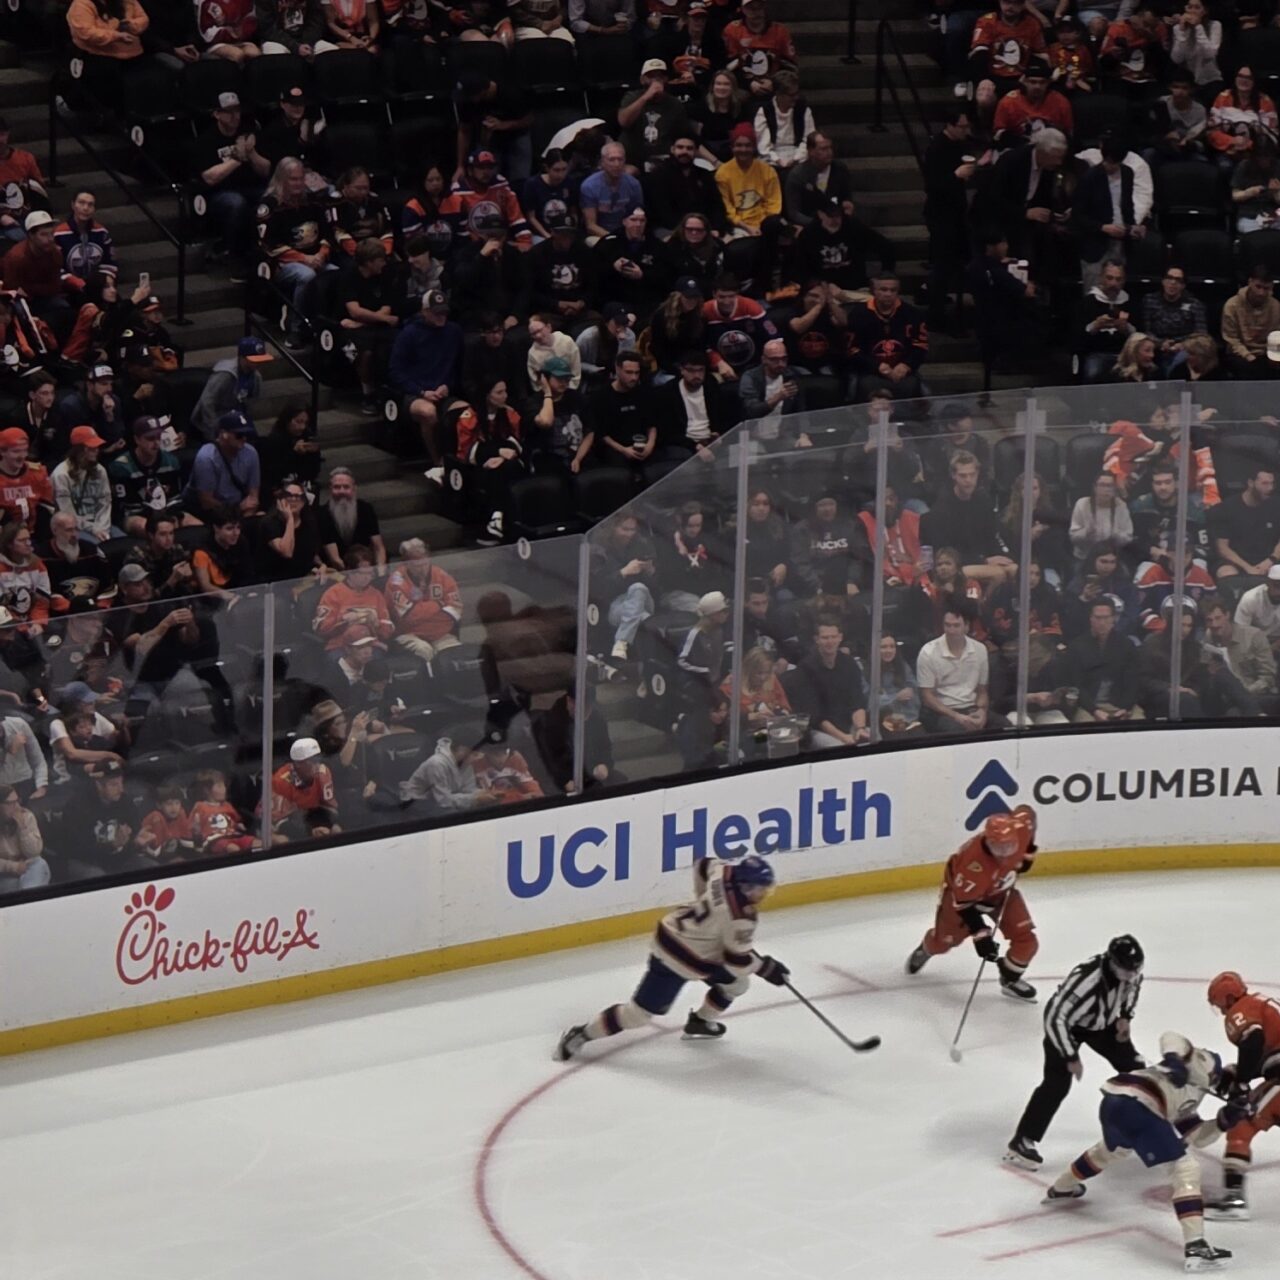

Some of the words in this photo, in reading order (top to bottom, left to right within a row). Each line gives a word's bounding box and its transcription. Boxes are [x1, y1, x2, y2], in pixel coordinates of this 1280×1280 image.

[1032, 766, 1263, 805] COLUMBIA
[507, 820, 631, 899] UCI
[661, 779, 892, 873] Health
[116, 909, 320, 985] Chick-fil-A
